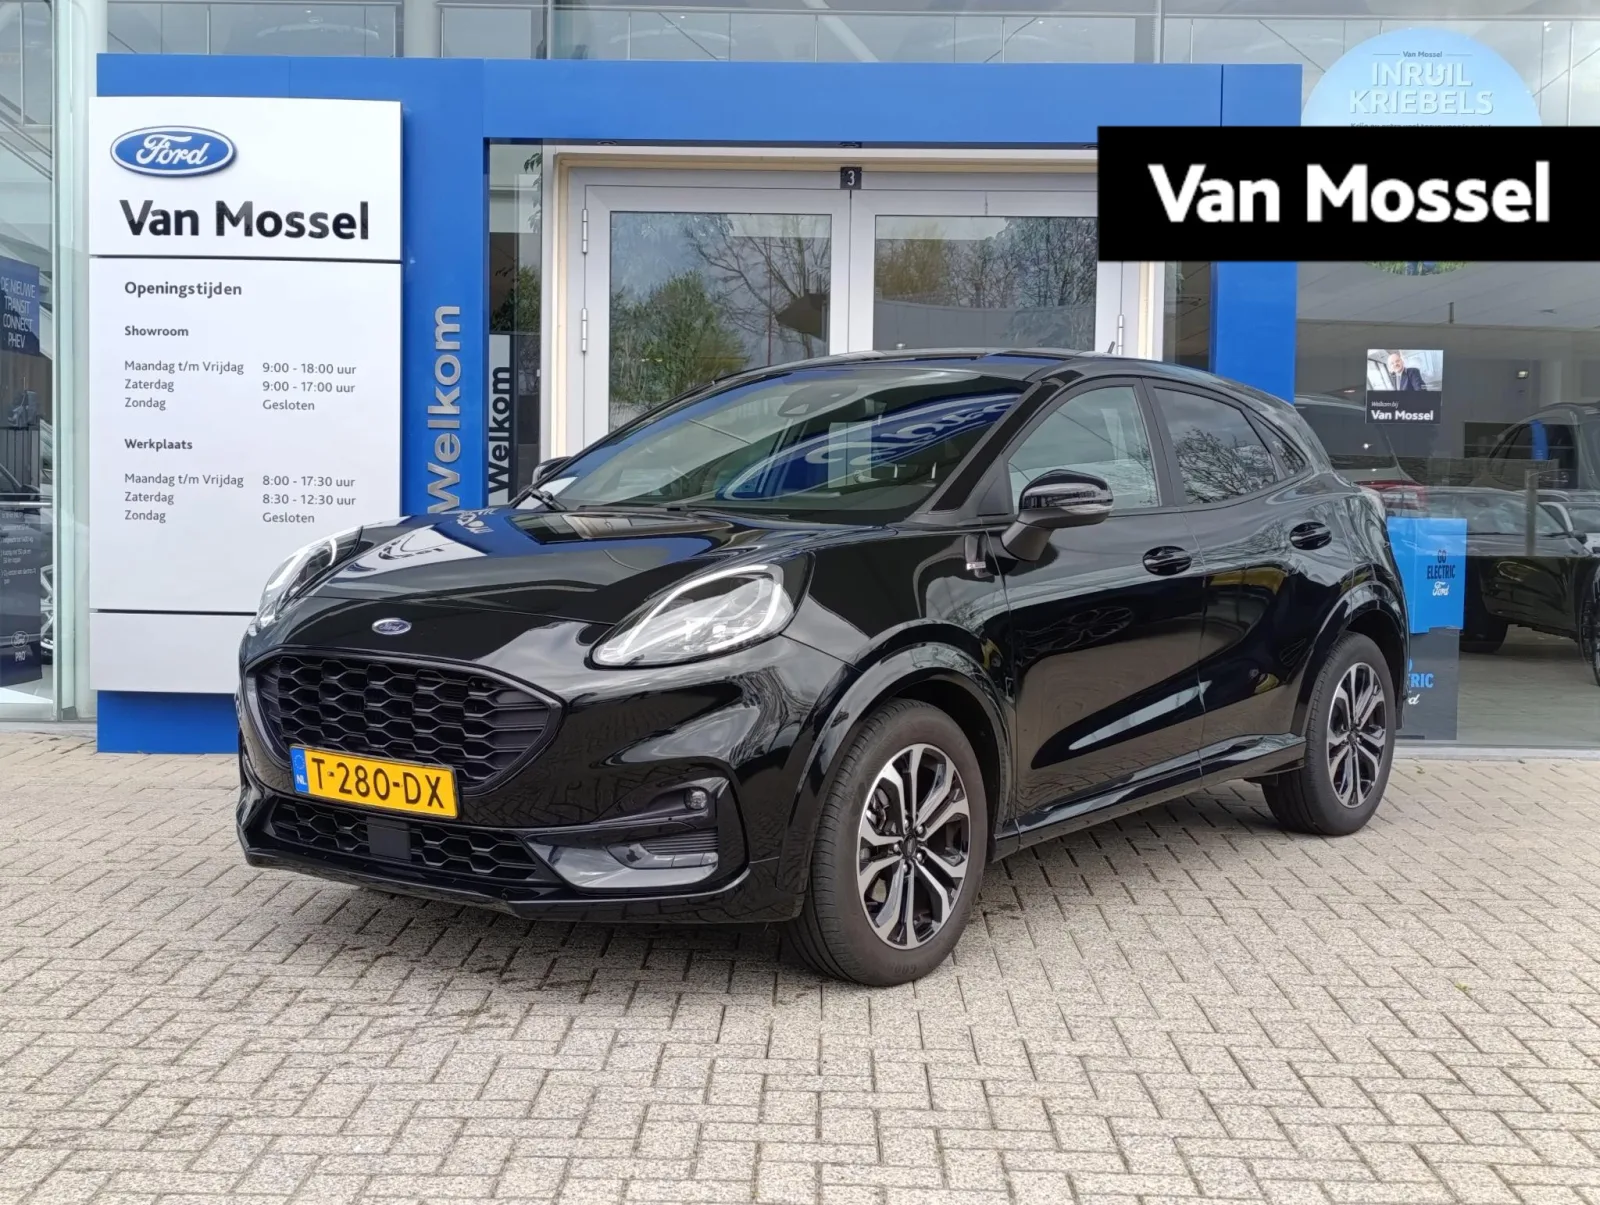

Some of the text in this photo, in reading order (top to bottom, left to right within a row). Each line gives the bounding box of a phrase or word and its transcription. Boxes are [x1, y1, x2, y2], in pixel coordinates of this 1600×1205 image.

[1402, 50, 1416, 58] Van
[1372, 60, 1473, 87] INRUIL
[1350, 89, 1494, 116] KRIEBELS
[135, 133, 210, 165] Ford
[847, 170, 855, 186] 3
[119, 199, 369, 240] Van Mossel
[10, 279, 36, 298] NIEUWE
[124, 280, 243, 299] Openingstijden
[4, 295, 30, 313] TRANSIT
[3, 313, 33, 331] CONNECT
[124, 325, 189, 337] Showroom
[8, 332, 26, 348] PHEV
[124, 359, 176, 374] Maandag
[178, 360, 200, 372] t/m
[202, 361, 245, 376] Vrijdag
[262, 361, 290, 374] 9:00
[300, 362, 334, 375] 18:00
[336, 365, 357, 375] uur
[124, 378, 175, 393] Zaterdag
[262, 380, 290, 392] 9:00
[300, 381, 333, 393] 17:00
[335, 384, 356, 393] uur
[124, 396, 315, 412] Zondag Gesloten
[428, 306, 461, 514] Welkom
[1371, 409, 1434, 421] Van Mossel
[488, 366, 511, 494] Welkom
[124, 438, 193, 453] Werkplaats
[124, 472, 176, 488] Maandag
[178, 473, 200, 485] t/m
[202, 474, 245, 489] Vrijdag
[262, 474, 290, 487] 8:00
[300, 475, 333, 488] 17:30
[335, 478, 356, 488] uur
[124, 491, 175, 506] Zaterdag
[262, 493, 290, 505] 8:30
[300, 494, 334, 506] 12:30
[336, 497, 357, 506] uur
[124, 509, 315, 524] Zondag Gesloten
[1437, 550, 1447, 563] GO
[1426, 565, 1456, 579] ELECTRIC
[1432, 581, 1450, 596] Ford
[296, 774, 307, 785] NL
[311, 757, 445, 809] T-280-DX
